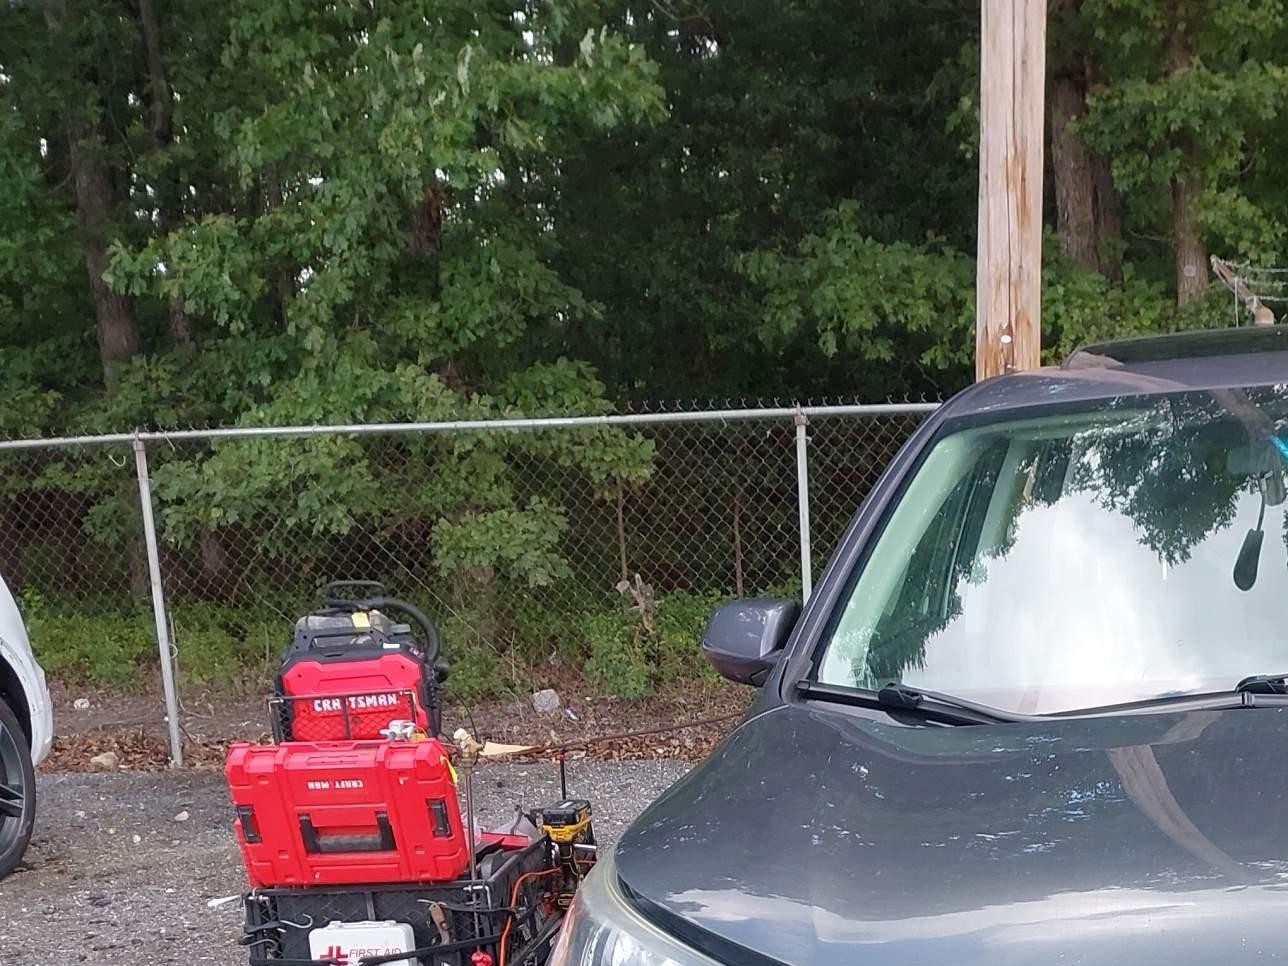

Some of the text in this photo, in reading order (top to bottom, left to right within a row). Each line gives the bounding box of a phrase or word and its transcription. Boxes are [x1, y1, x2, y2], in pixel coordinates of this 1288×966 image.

[314, 694, 397, 712] CRATSMAN
[308, 780, 363, 789] CRAFTMAN
[349, 948, 380, 958] FIRST
